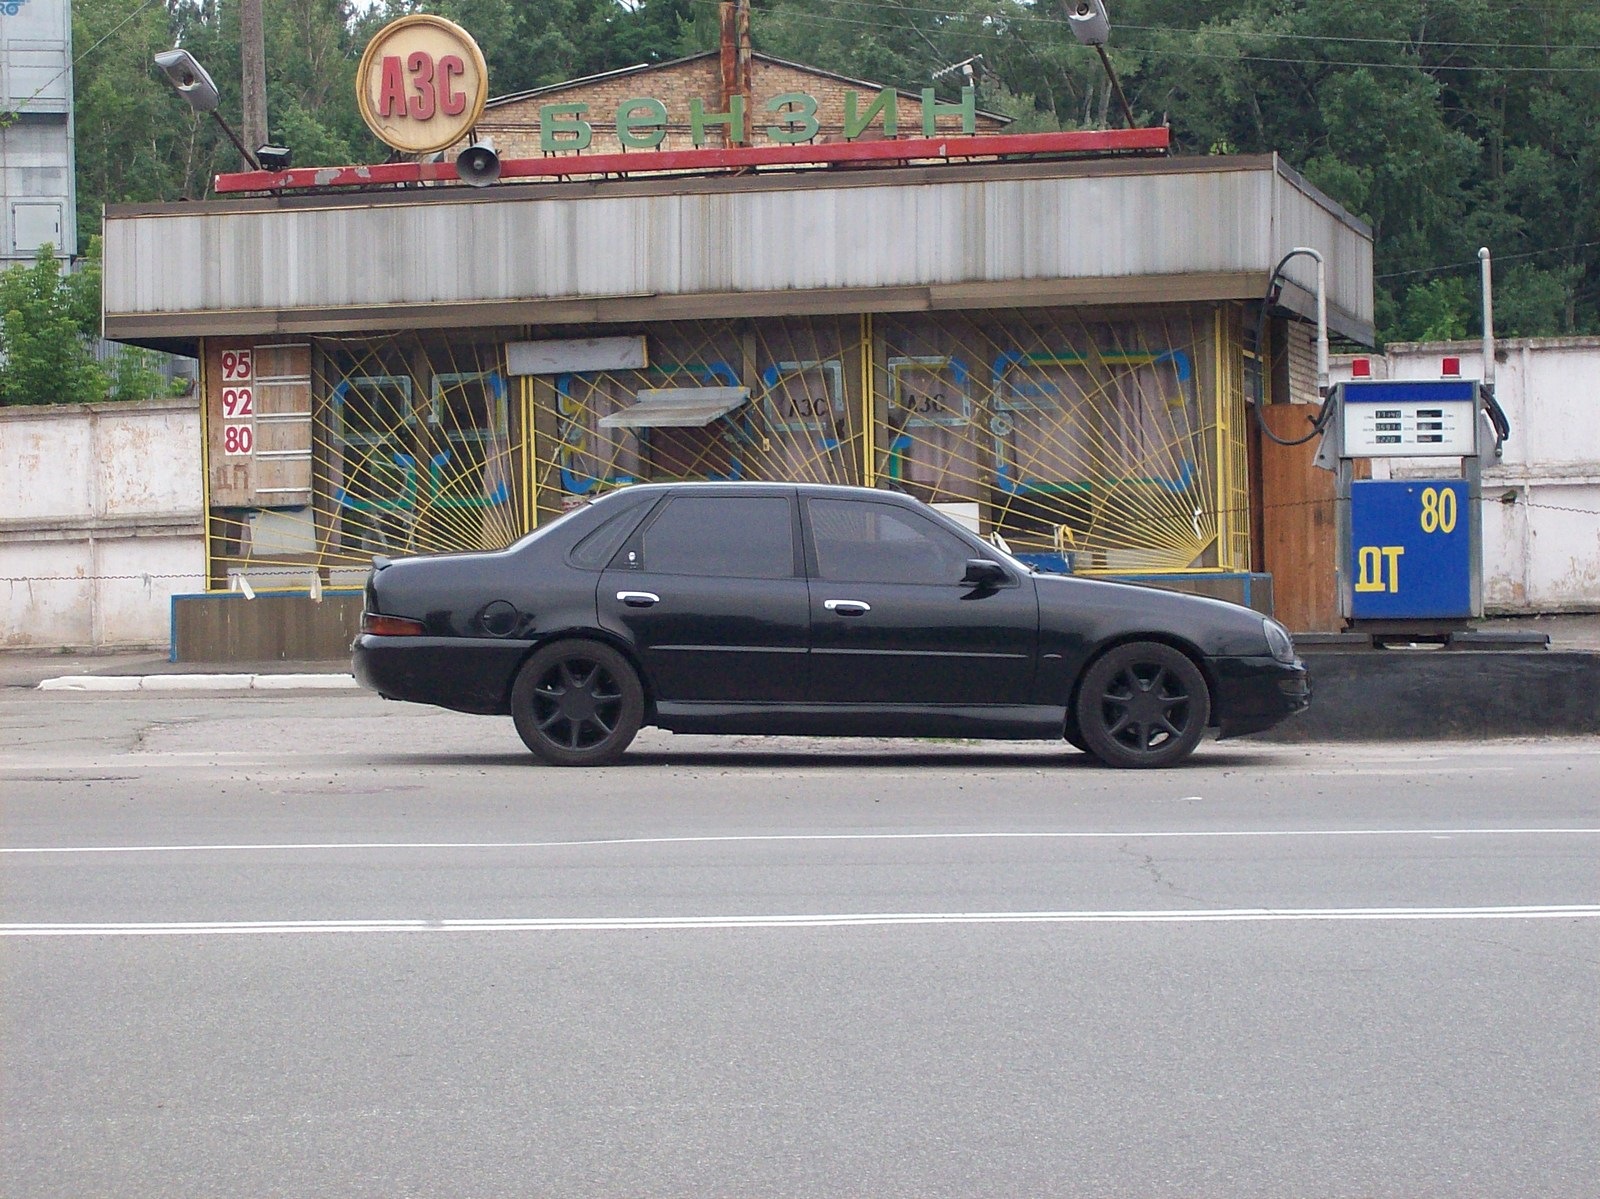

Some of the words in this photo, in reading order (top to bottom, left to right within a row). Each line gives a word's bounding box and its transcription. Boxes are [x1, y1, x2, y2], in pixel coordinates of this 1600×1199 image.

[379, 51, 467, 121] АЗС
[222, 352, 251, 379] 95
[223, 389, 252, 416] 92
[788, 398, 826, 418] АЗС
[907, 393, 946, 413] АЗС
[225, 426, 253, 453] 80
[1421, 487, 1457, 533] 80
[1355, 546, 1405, 593] ДТ
